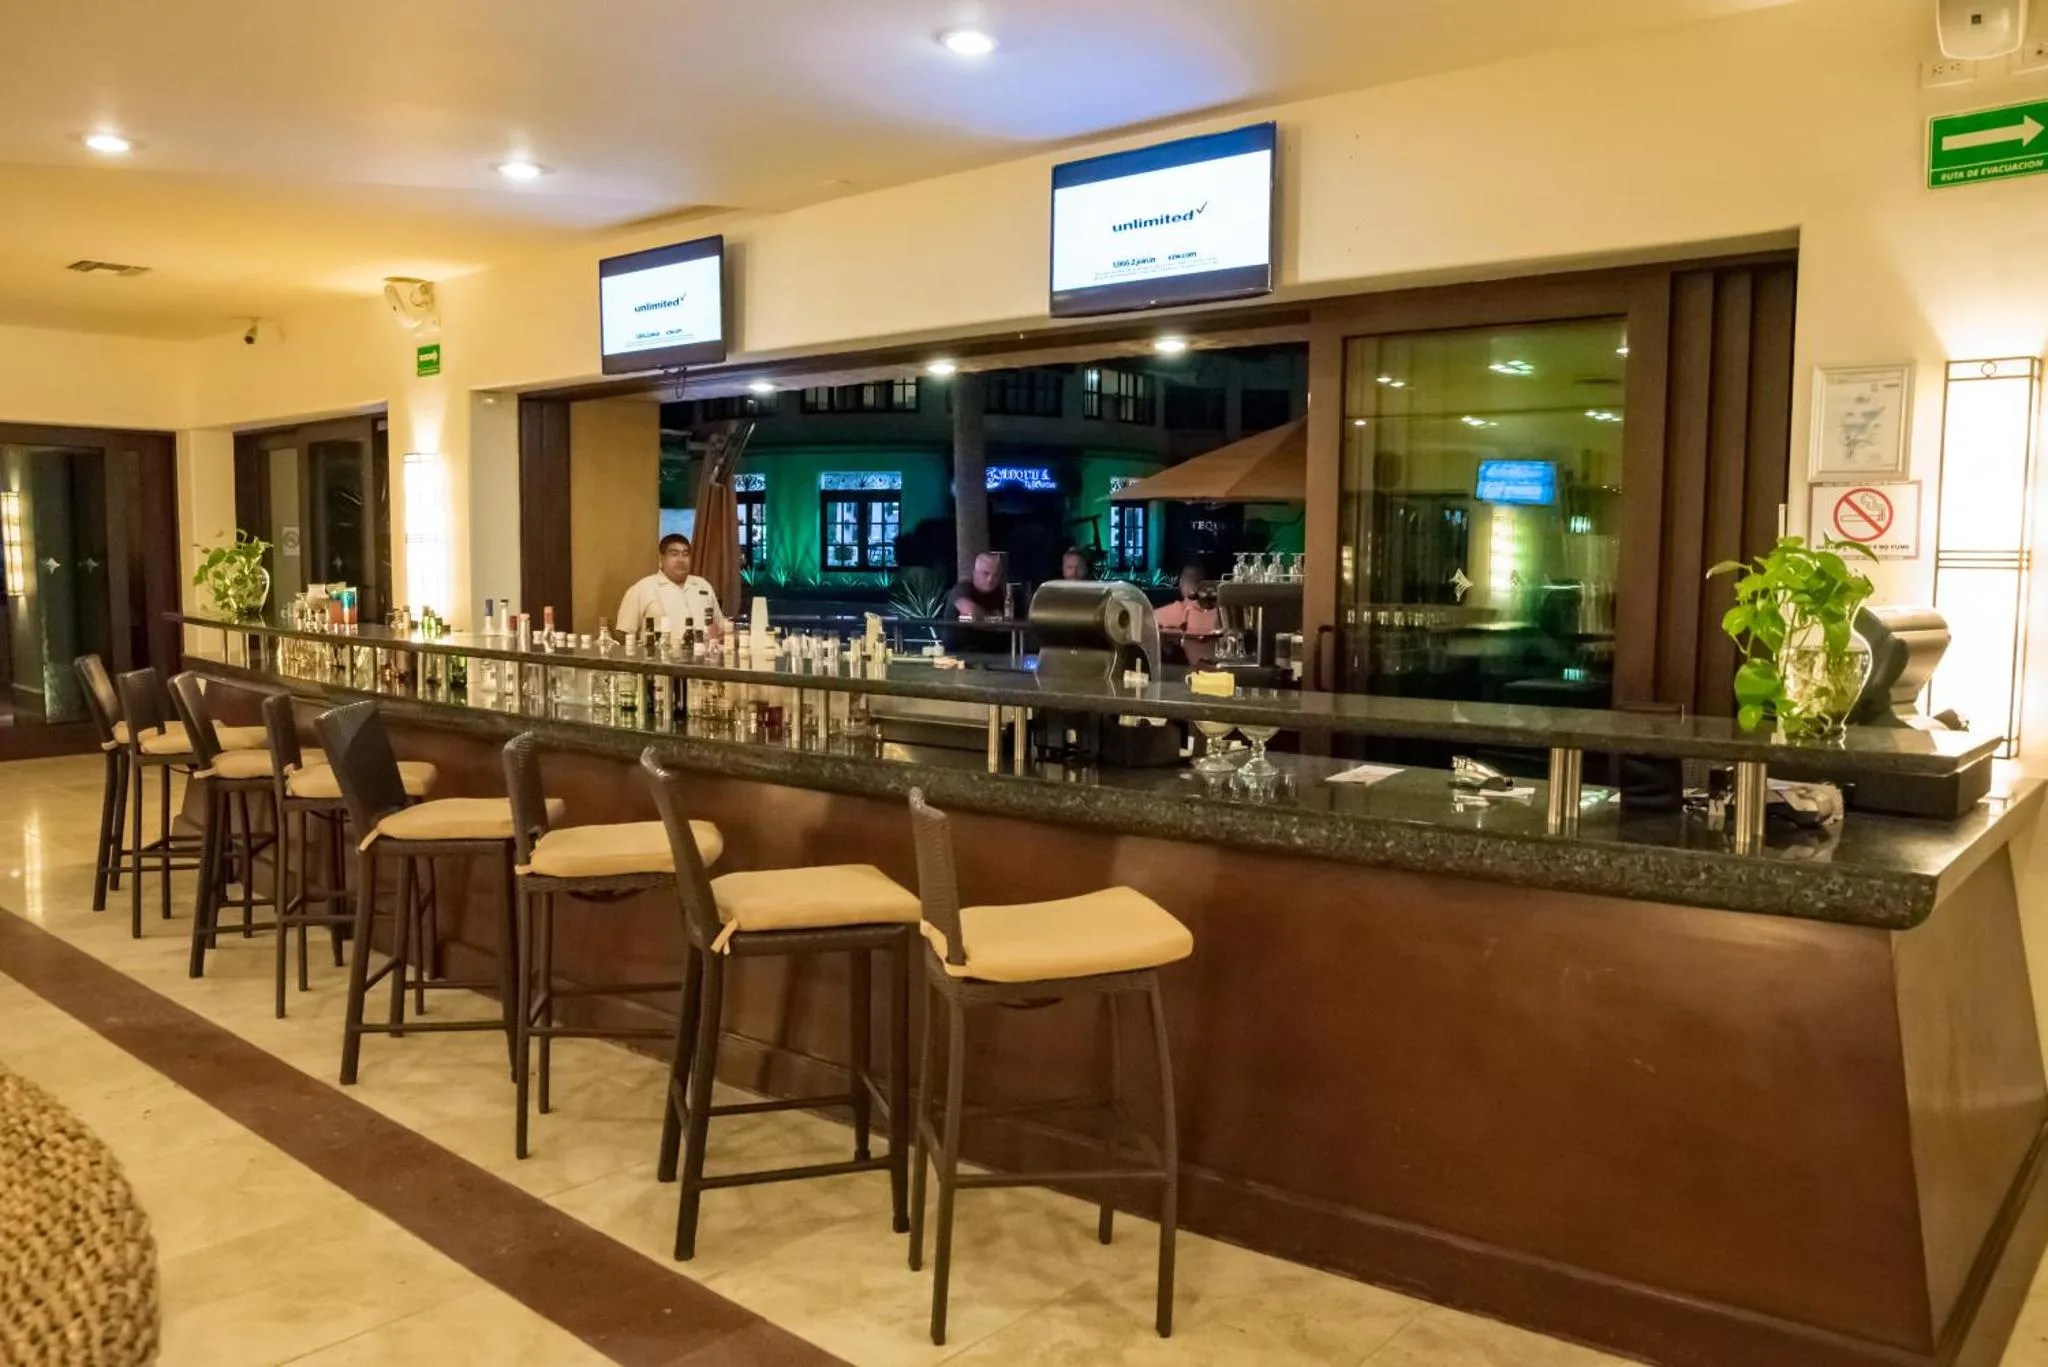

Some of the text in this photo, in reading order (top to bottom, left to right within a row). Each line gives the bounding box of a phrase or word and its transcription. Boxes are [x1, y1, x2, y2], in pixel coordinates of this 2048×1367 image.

[1940, 159, 2044, 181] RUTA DE EVACUACION
[1112, 209, 1195, 233] unlimited
[634, 298, 680, 313] unlimited
